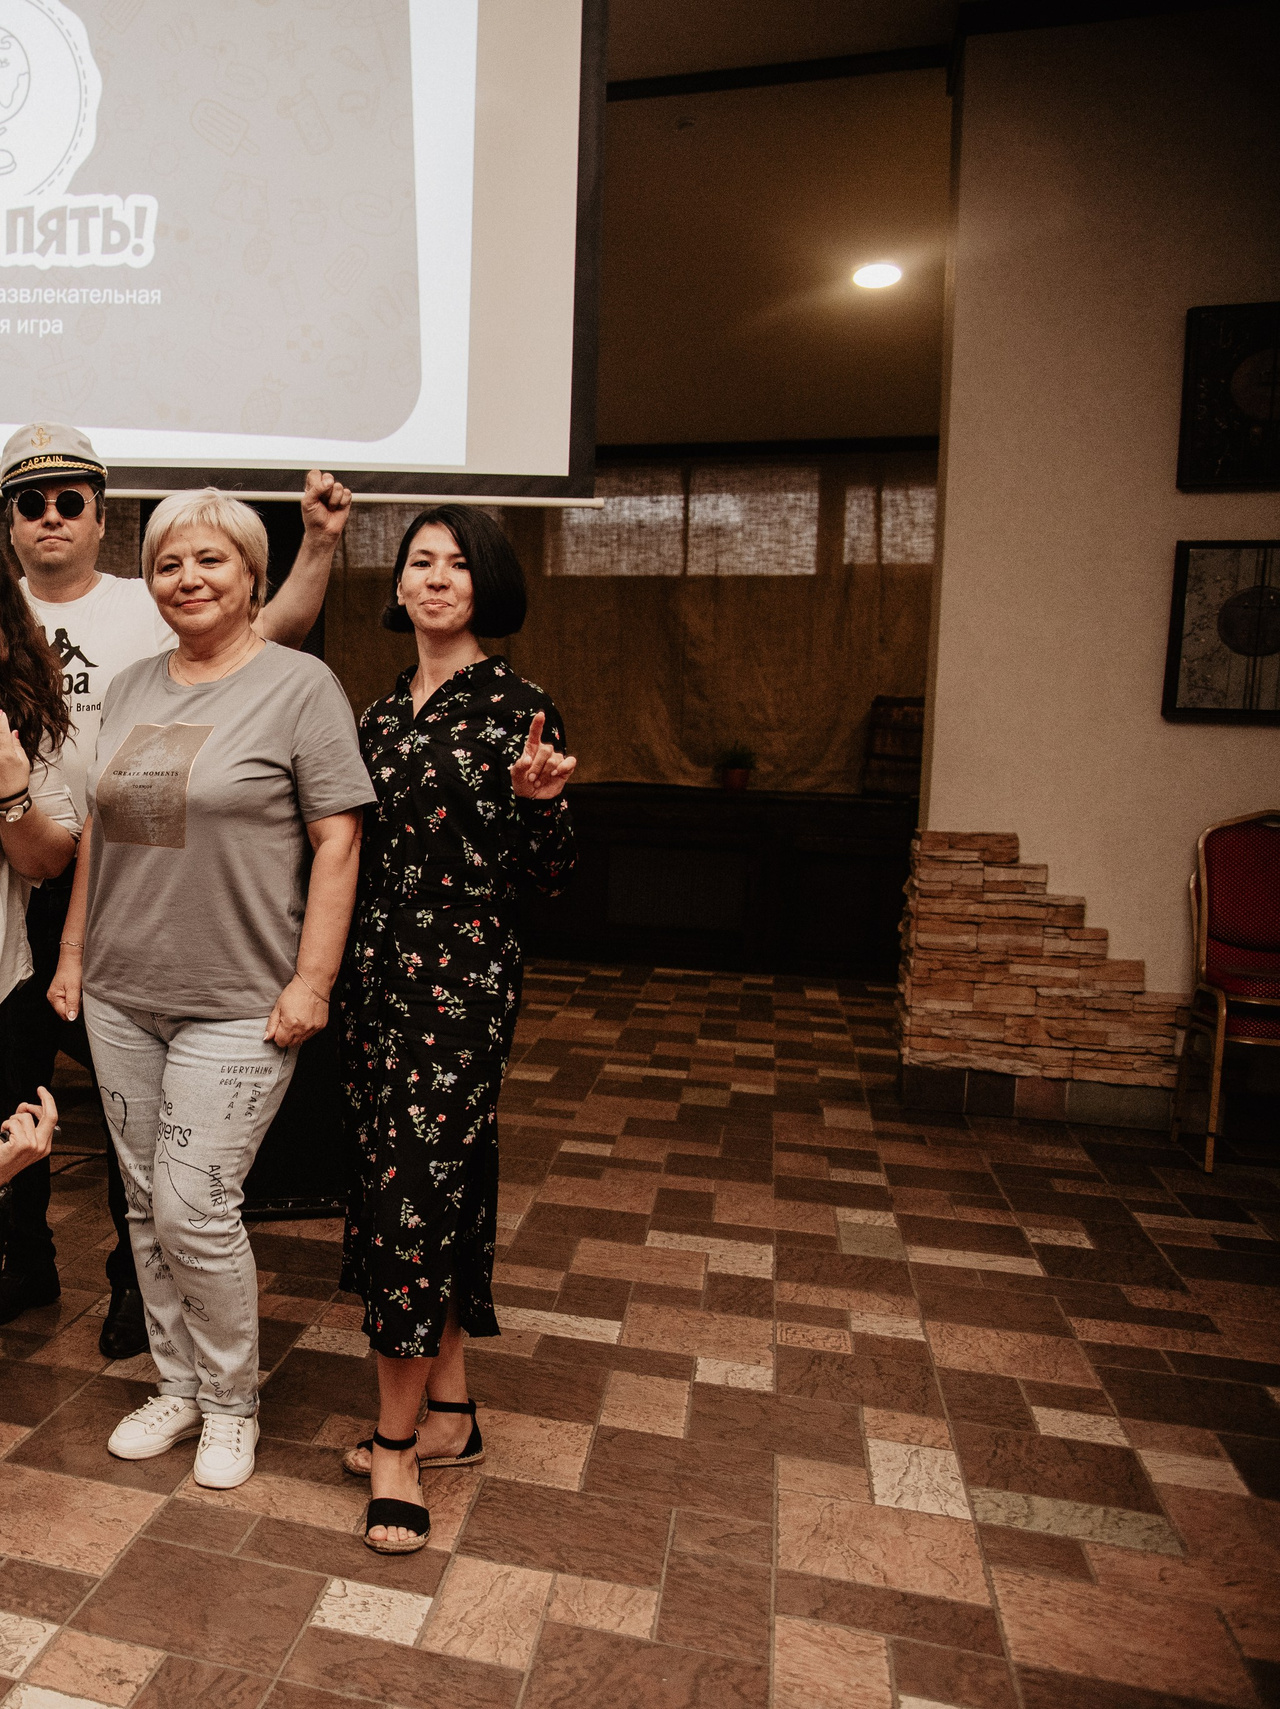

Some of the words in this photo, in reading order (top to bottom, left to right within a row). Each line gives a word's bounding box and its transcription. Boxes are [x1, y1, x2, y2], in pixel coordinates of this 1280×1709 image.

[6, 205, 148, 258] ПЯТЬ!
[17, 317, 64, 337] игра
[20, 455, 63, 469] CAPTAIN
[76, 701, 102, 712] Brand
[220, 1065, 273, 1075] EVERYTHING
[244, 1082, 262, 1117] JEANS
